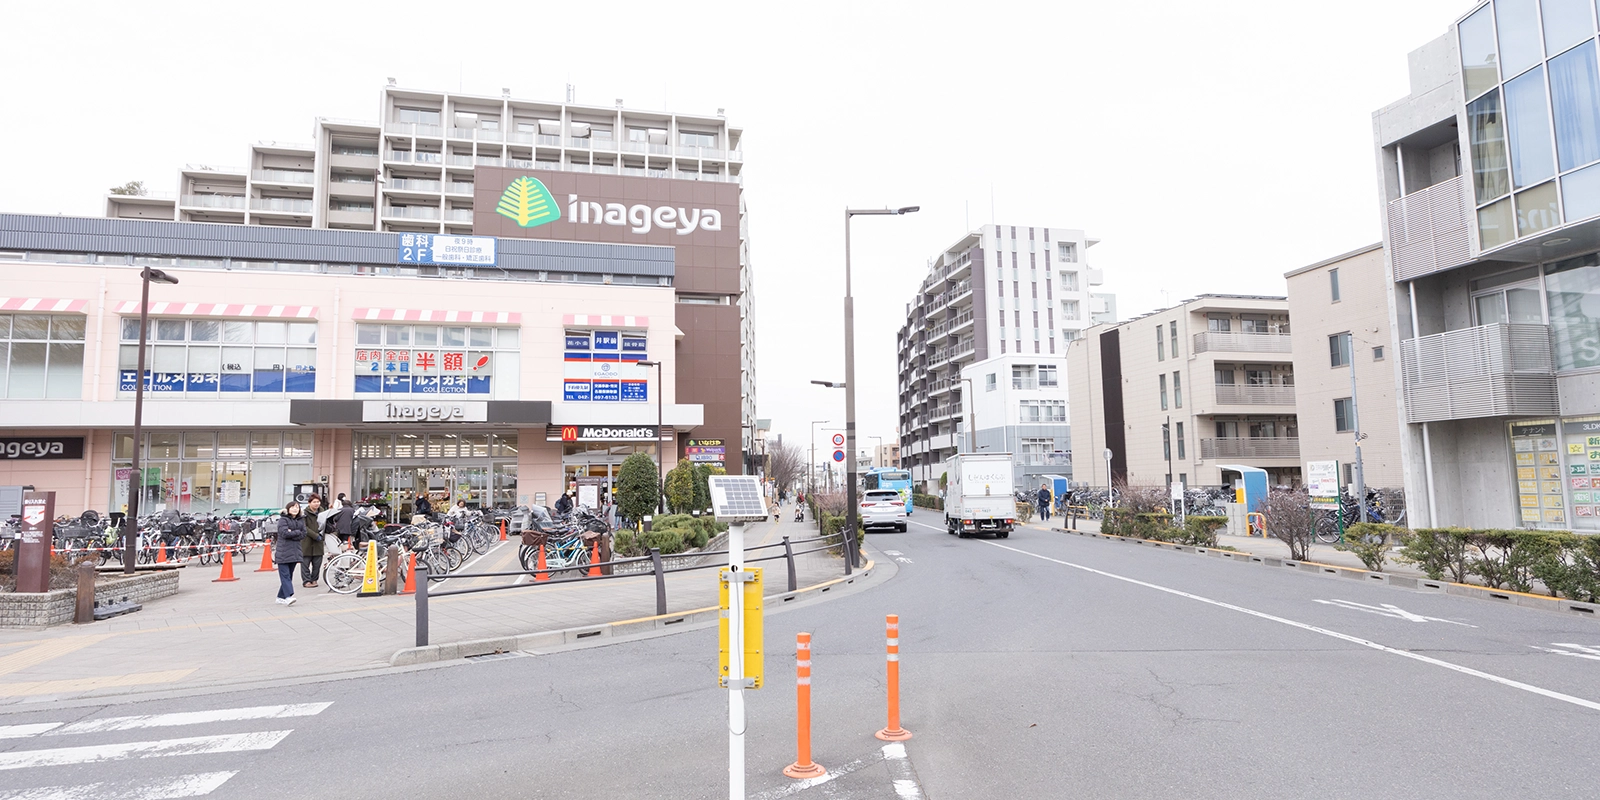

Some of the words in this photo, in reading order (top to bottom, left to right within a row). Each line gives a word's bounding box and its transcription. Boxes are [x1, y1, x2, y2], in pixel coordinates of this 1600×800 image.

[568, 194, 721, 235] inageya
[402, 234, 428, 247] 歯科
[403, 248, 426, 261] 2F
[356, 350, 409, 361] 店内全品
[371, 362, 408, 372] 2本目
[385, 403, 464, 420] inageya
[582, 428, 654, 438] McDonald's
